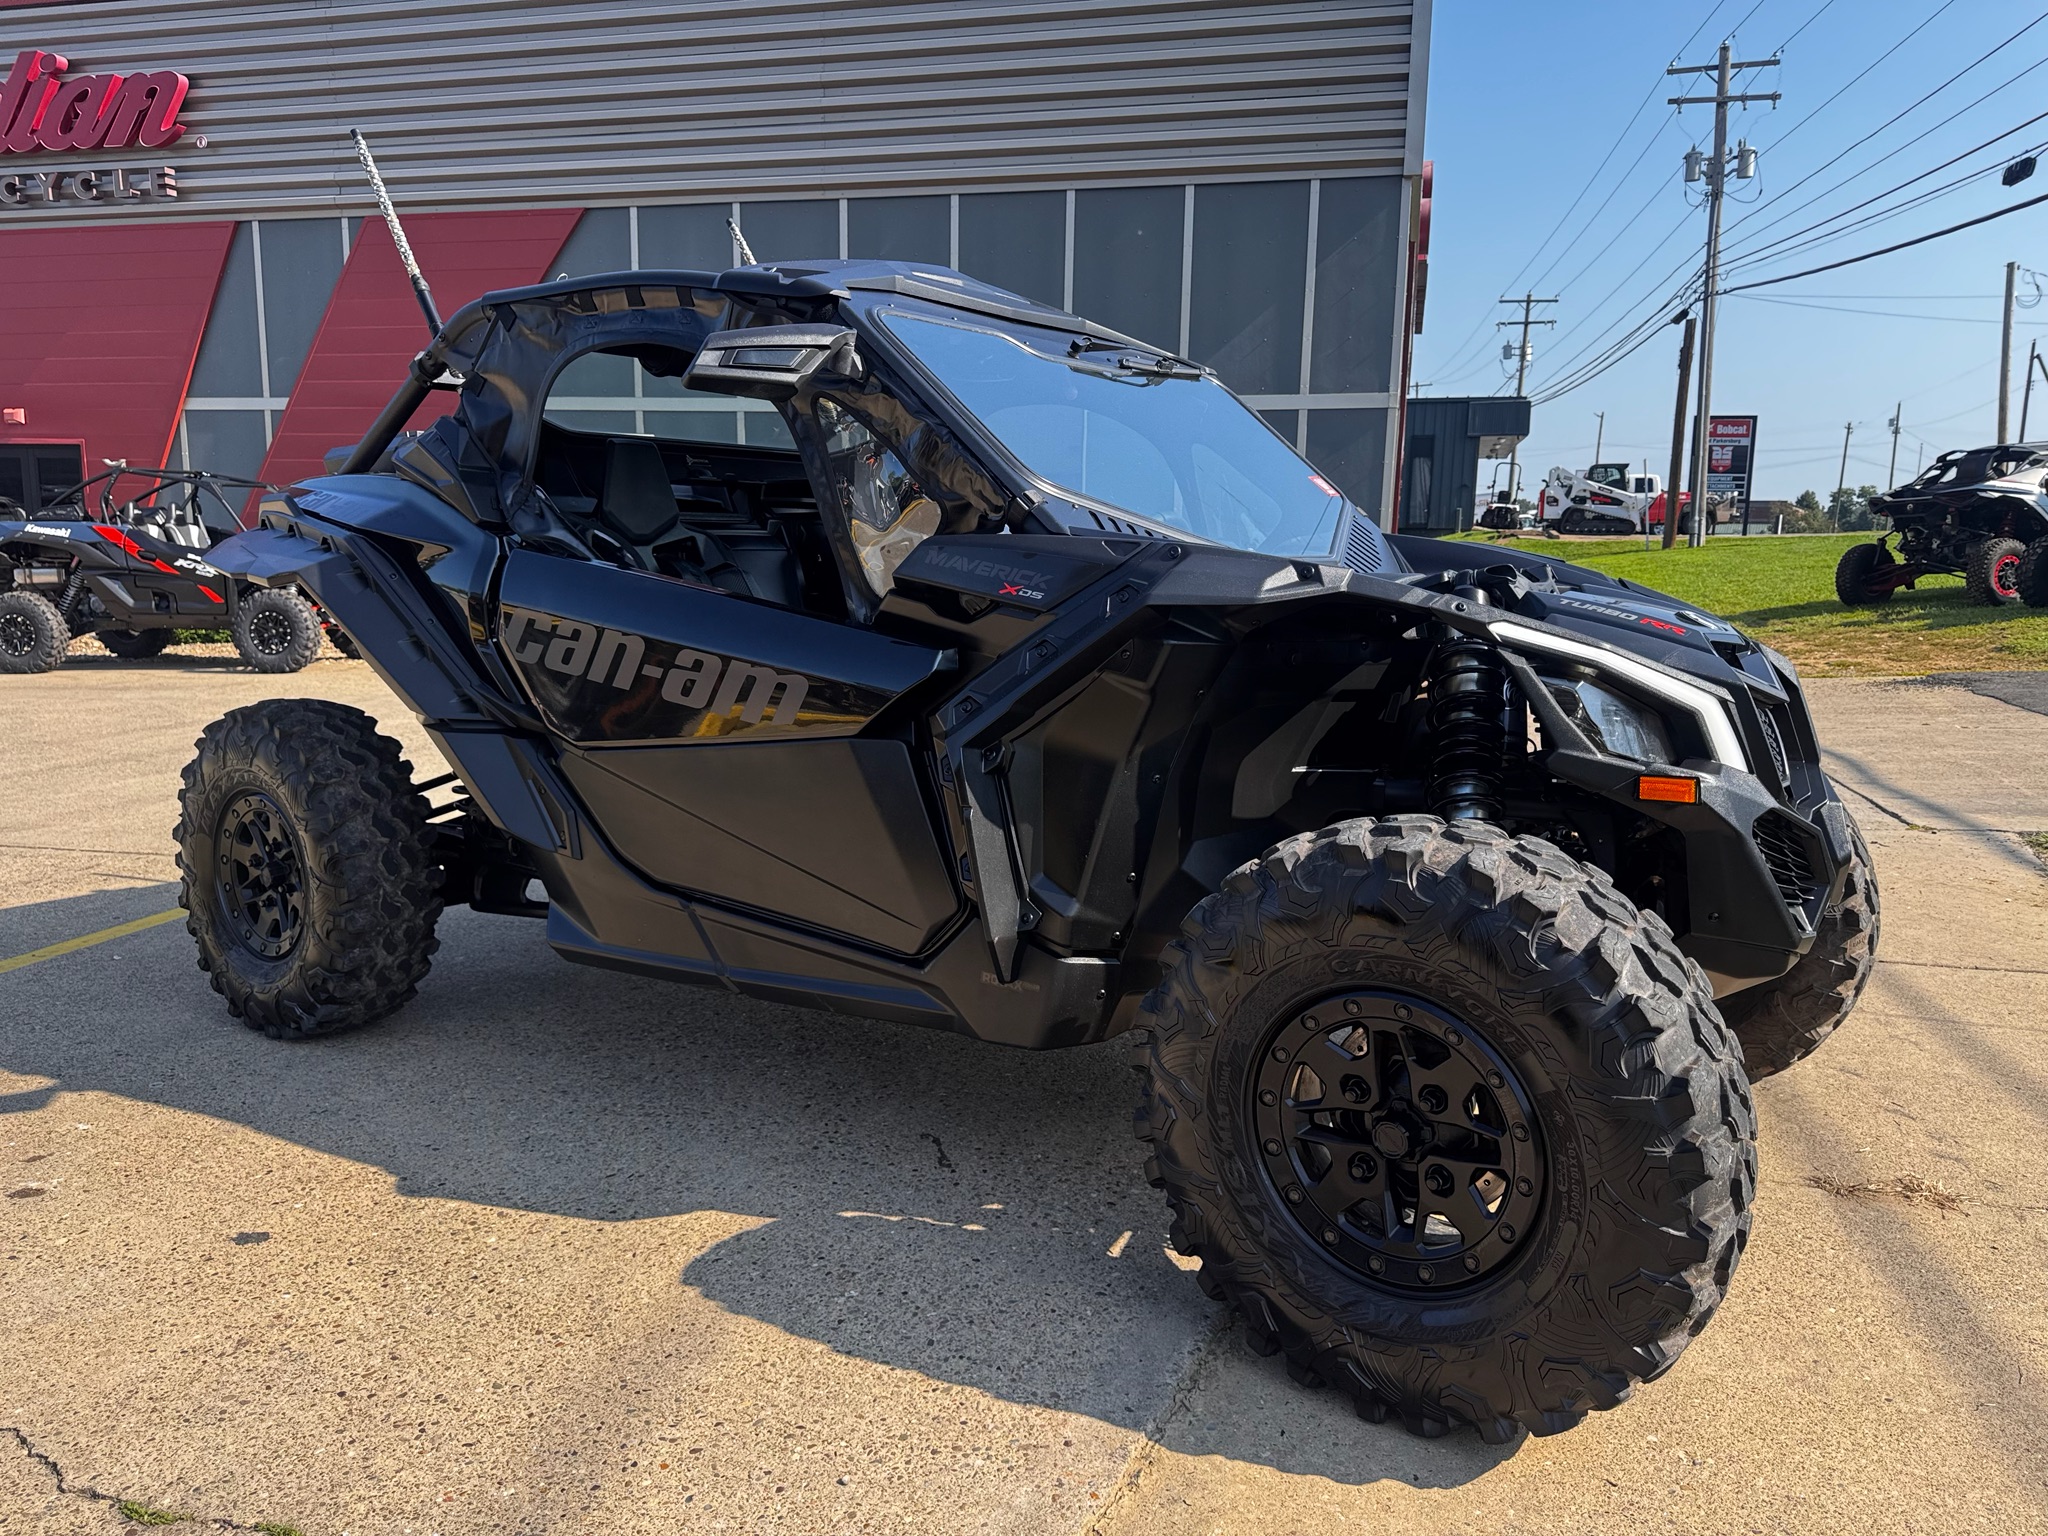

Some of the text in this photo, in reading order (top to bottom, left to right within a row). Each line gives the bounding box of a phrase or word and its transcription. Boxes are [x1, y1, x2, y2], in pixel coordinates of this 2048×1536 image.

[0, 166, 178, 204] CYCLE
[1717, 424, 1747, 435] Bobcat
[24, 523, 72, 538] Kawasaki
[925, 549, 1054, 590] MAVERICK
[1559, 597, 1687, 636] TURBO RR
[506, 607, 809, 726] can-am
[1330, 957, 1527, 1061] CARNIVORE
